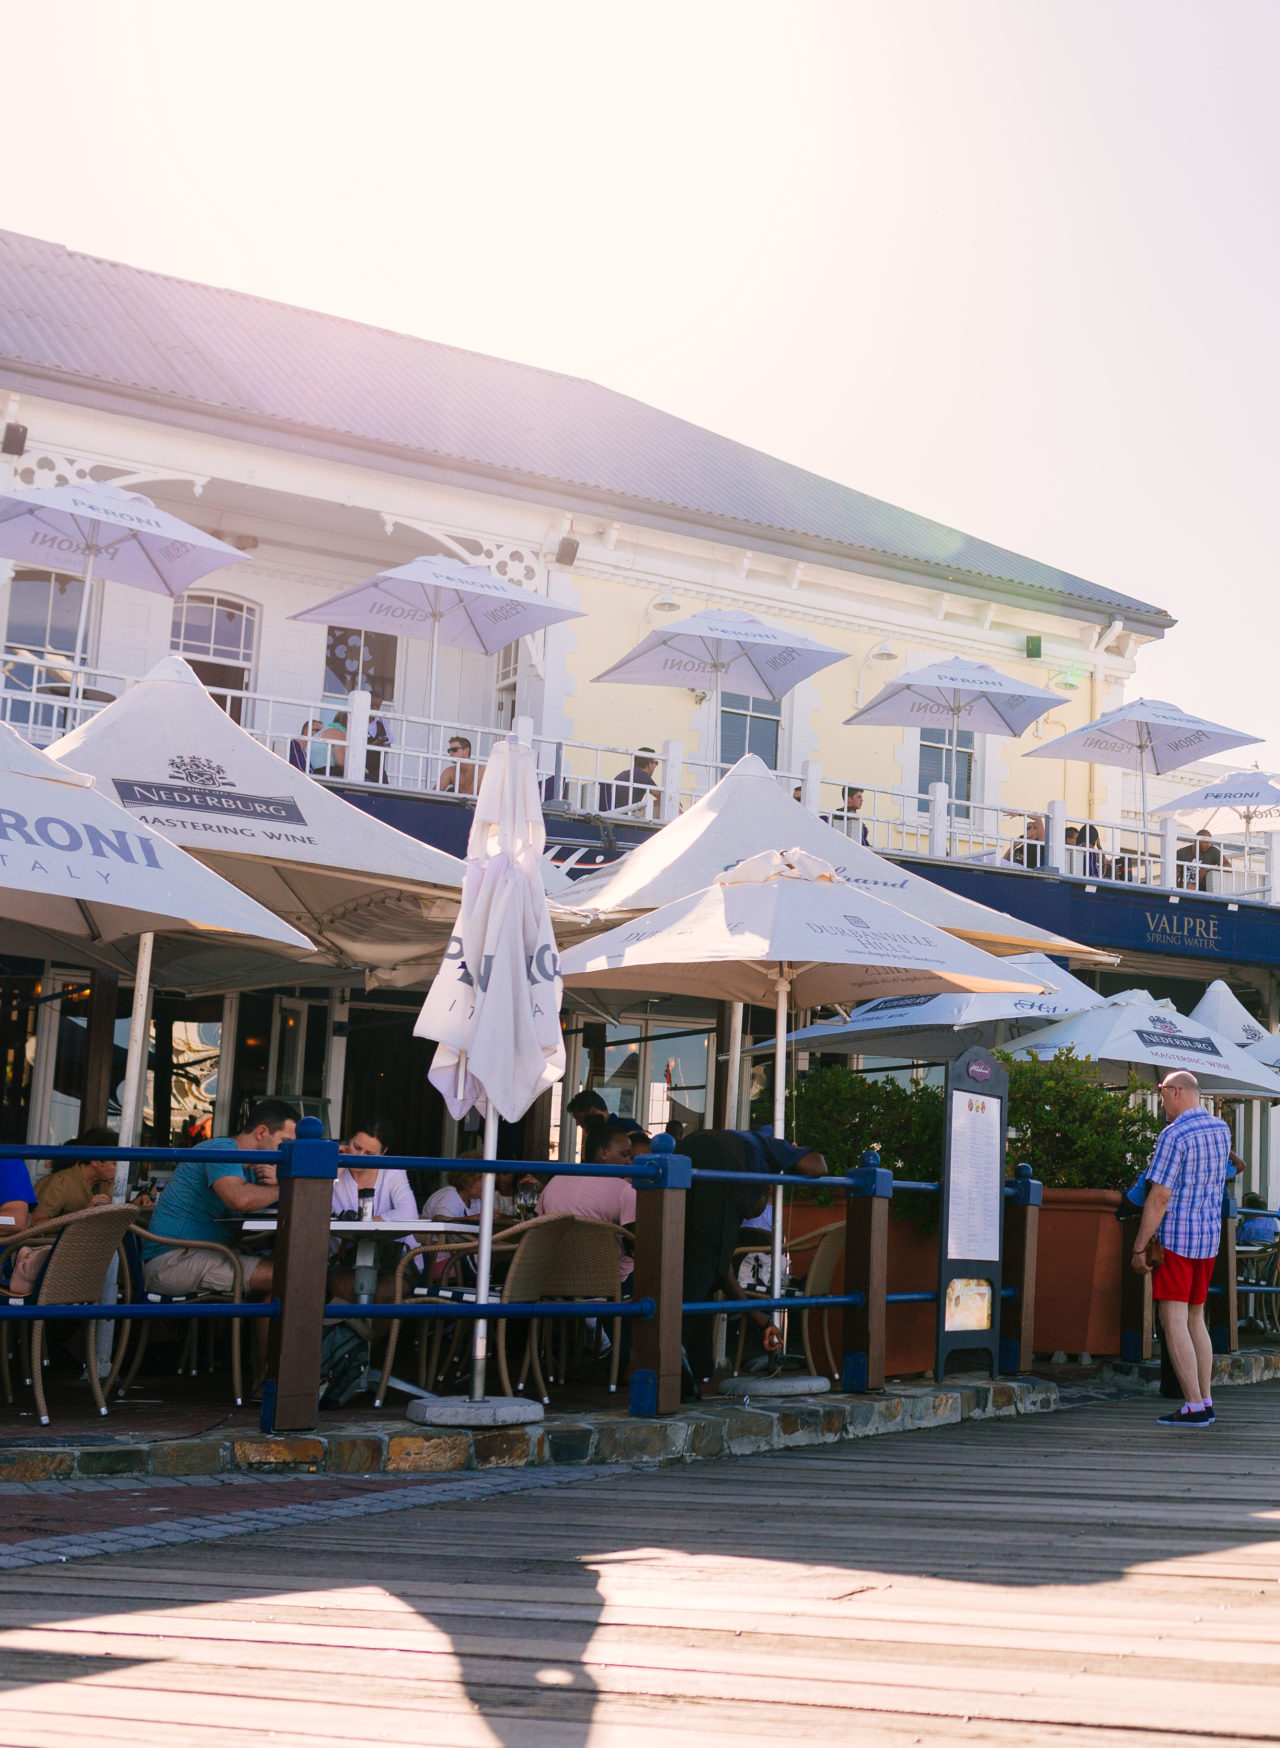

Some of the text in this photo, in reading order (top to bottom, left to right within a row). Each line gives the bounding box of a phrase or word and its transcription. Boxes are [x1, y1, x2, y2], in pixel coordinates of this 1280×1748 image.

[71, 498, 163, 529] PERONI
[431, 571, 508, 593] PERONI
[707, 625, 778, 640] PERONI
[937, 673, 1004, 687] PERONI
[133, 785, 287, 817] NEDERBURG
[1204, 791, 1260, 800] PERONI
[262, 830, 320, 846] WINE
[856, 938, 911, 953] HILLS
[1146, 932, 1220, 952] SPRING WATER
[1142, 1033, 1212, 1051] NEDERBURG
[1150, 1051, 1233, 1071] MASTERING WINE
